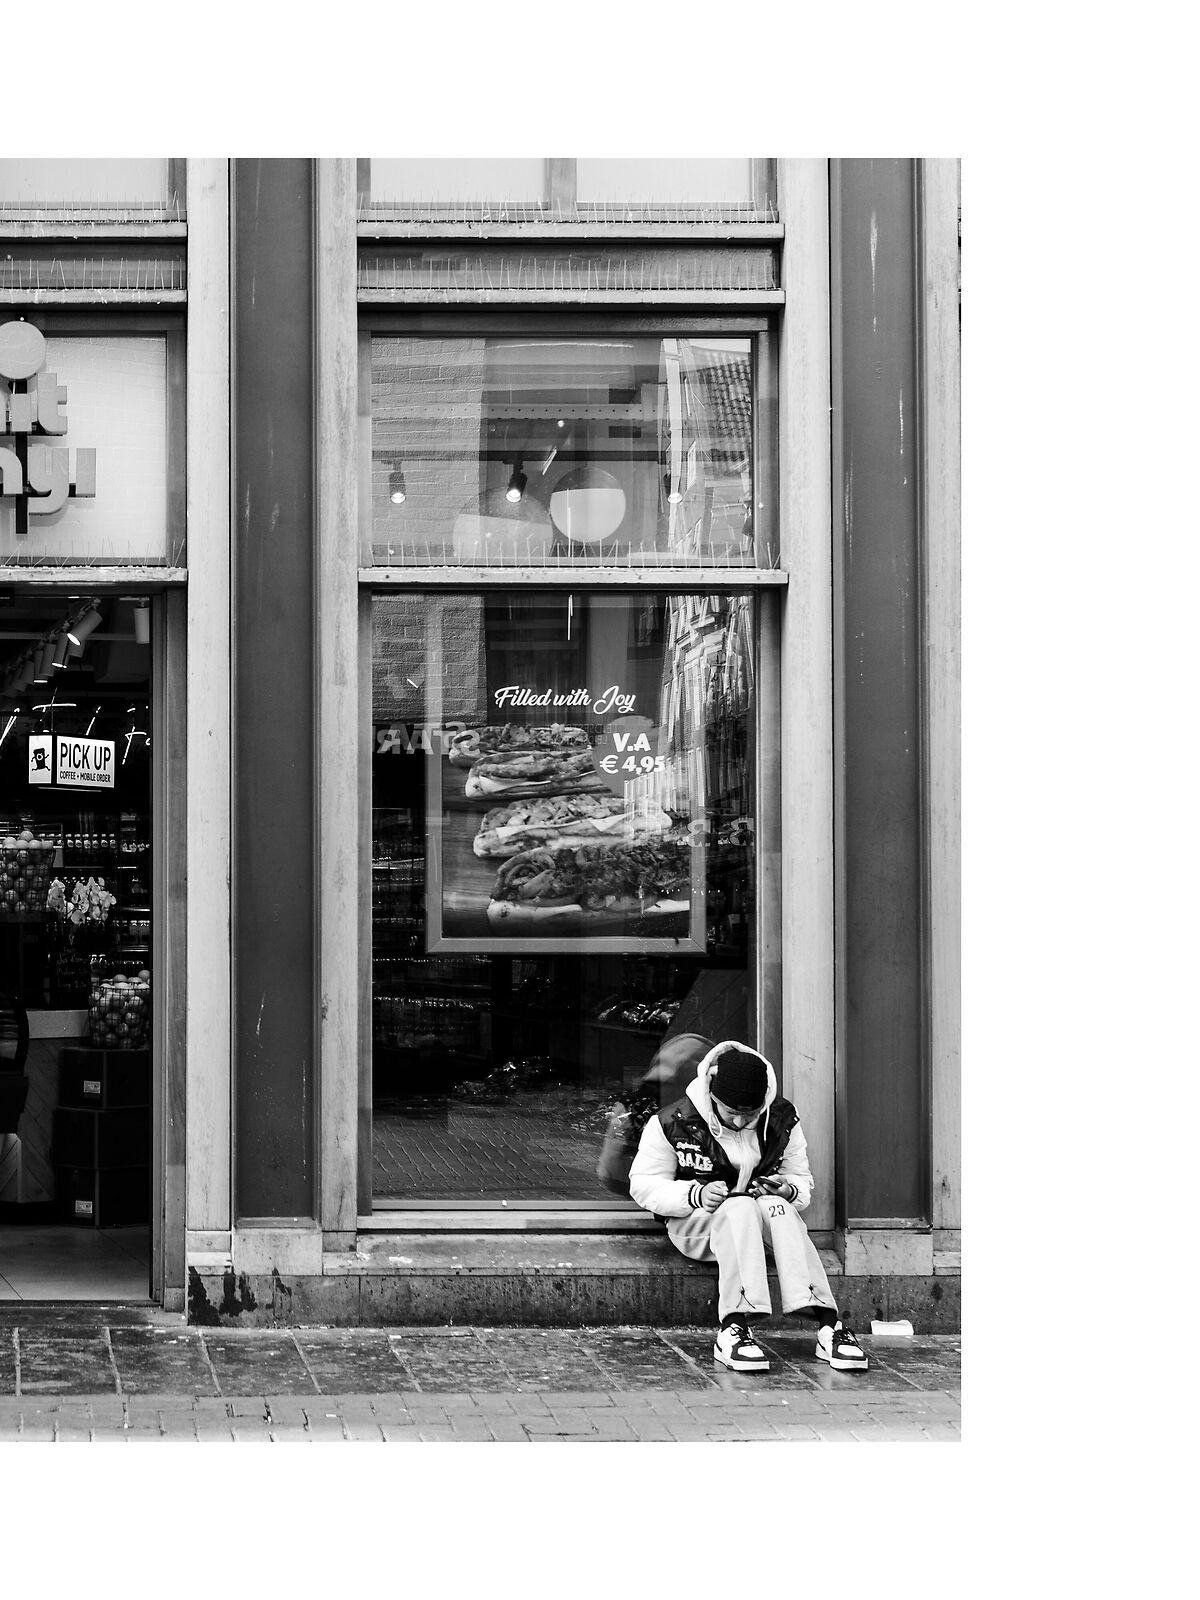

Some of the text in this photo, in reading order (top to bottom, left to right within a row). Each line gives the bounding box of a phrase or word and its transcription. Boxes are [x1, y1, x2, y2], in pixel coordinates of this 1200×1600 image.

[494, 685, 637, 715] Filled with Joy
[612, 733, 651, 752] V.A
[60, 742, 111, 771] PICK UP
[599, 754, 666, 775] € 4,95
[60, 770, 111, 783] COFFEE MOBILE ORDER
[768, 1204, 786, 1218] 23
